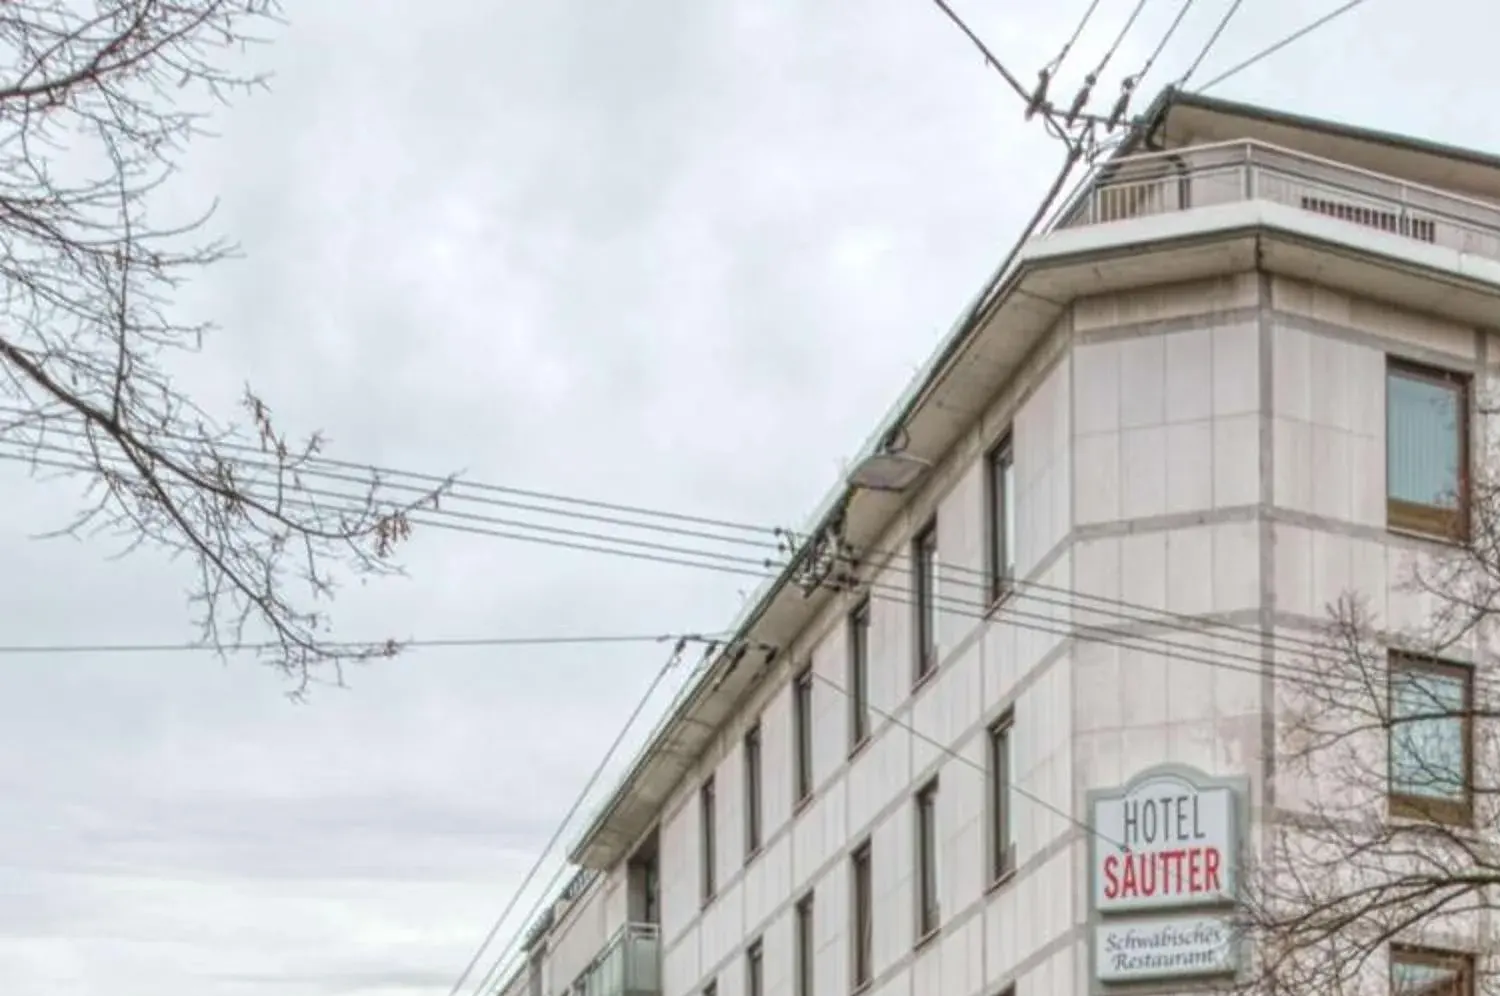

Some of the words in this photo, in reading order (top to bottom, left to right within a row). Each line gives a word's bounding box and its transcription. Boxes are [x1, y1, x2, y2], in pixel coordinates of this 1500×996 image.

[1124, 795, 1206, 844] HOTEL
[1104, 848, 1221, 899] SAUTTER
[1111, 949, 1214, 971] Restaurant
